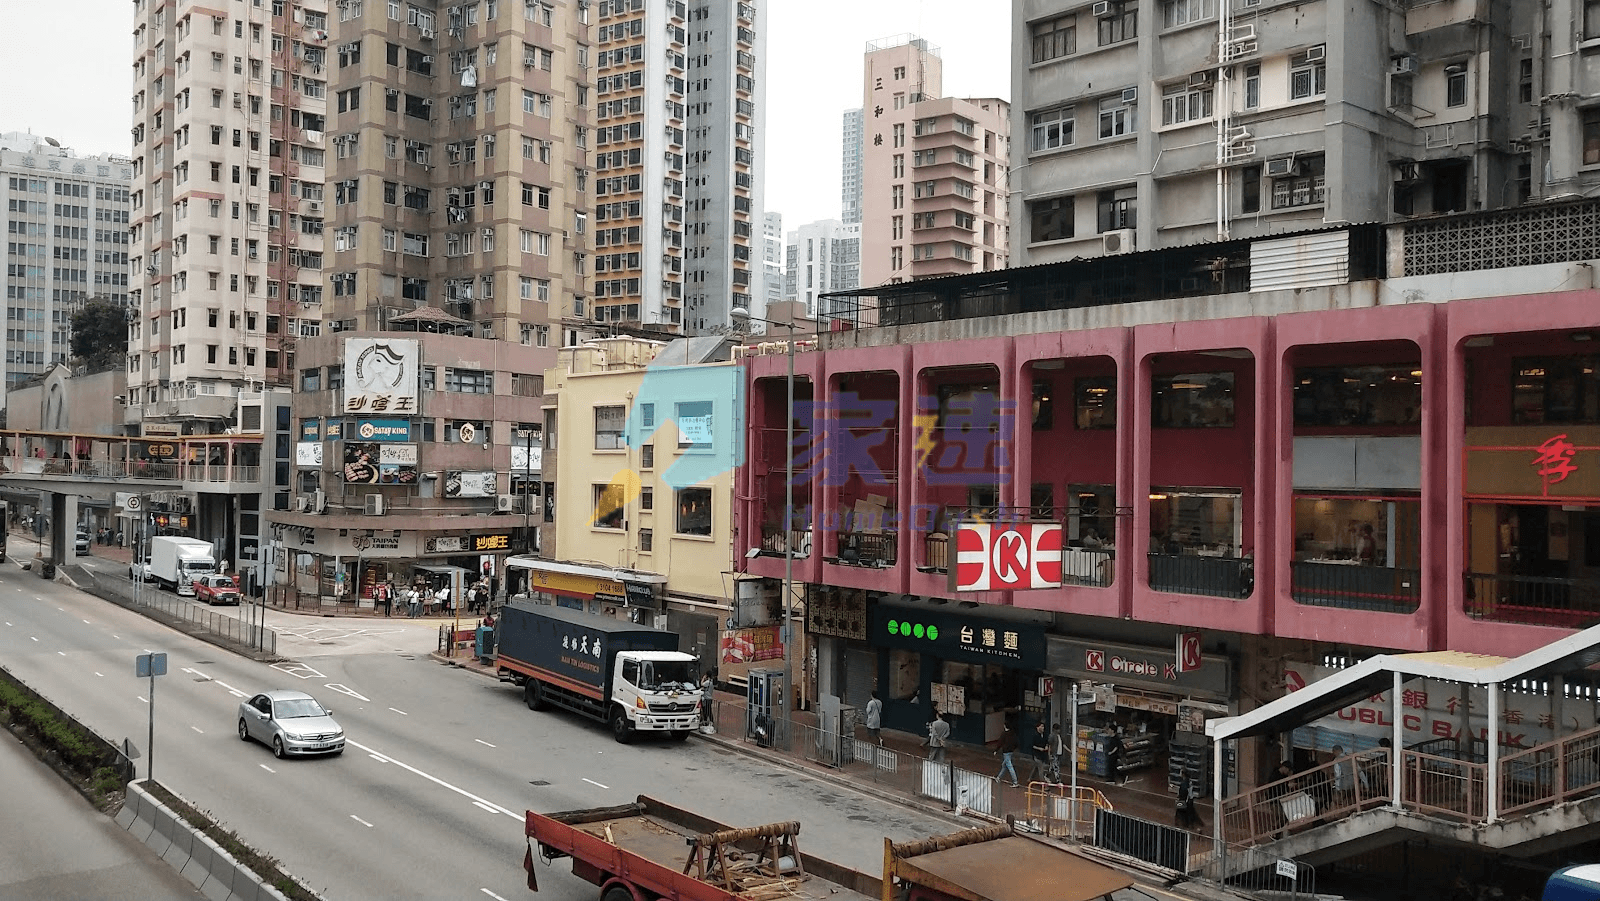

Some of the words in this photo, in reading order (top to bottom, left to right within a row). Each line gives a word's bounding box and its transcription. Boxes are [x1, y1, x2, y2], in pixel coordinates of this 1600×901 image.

[374, 426, 391, 437] SATAY
[392, 426, 408, 435] KING
[959, 645, 984, 653] TAIWAN
[986, 649, 1018, 658] KITCHEN
[1110, 655, 1158, 677] Circle
[1164, 662, 1177, 681] K
[1337, 706, 1422, 732] UBLC
